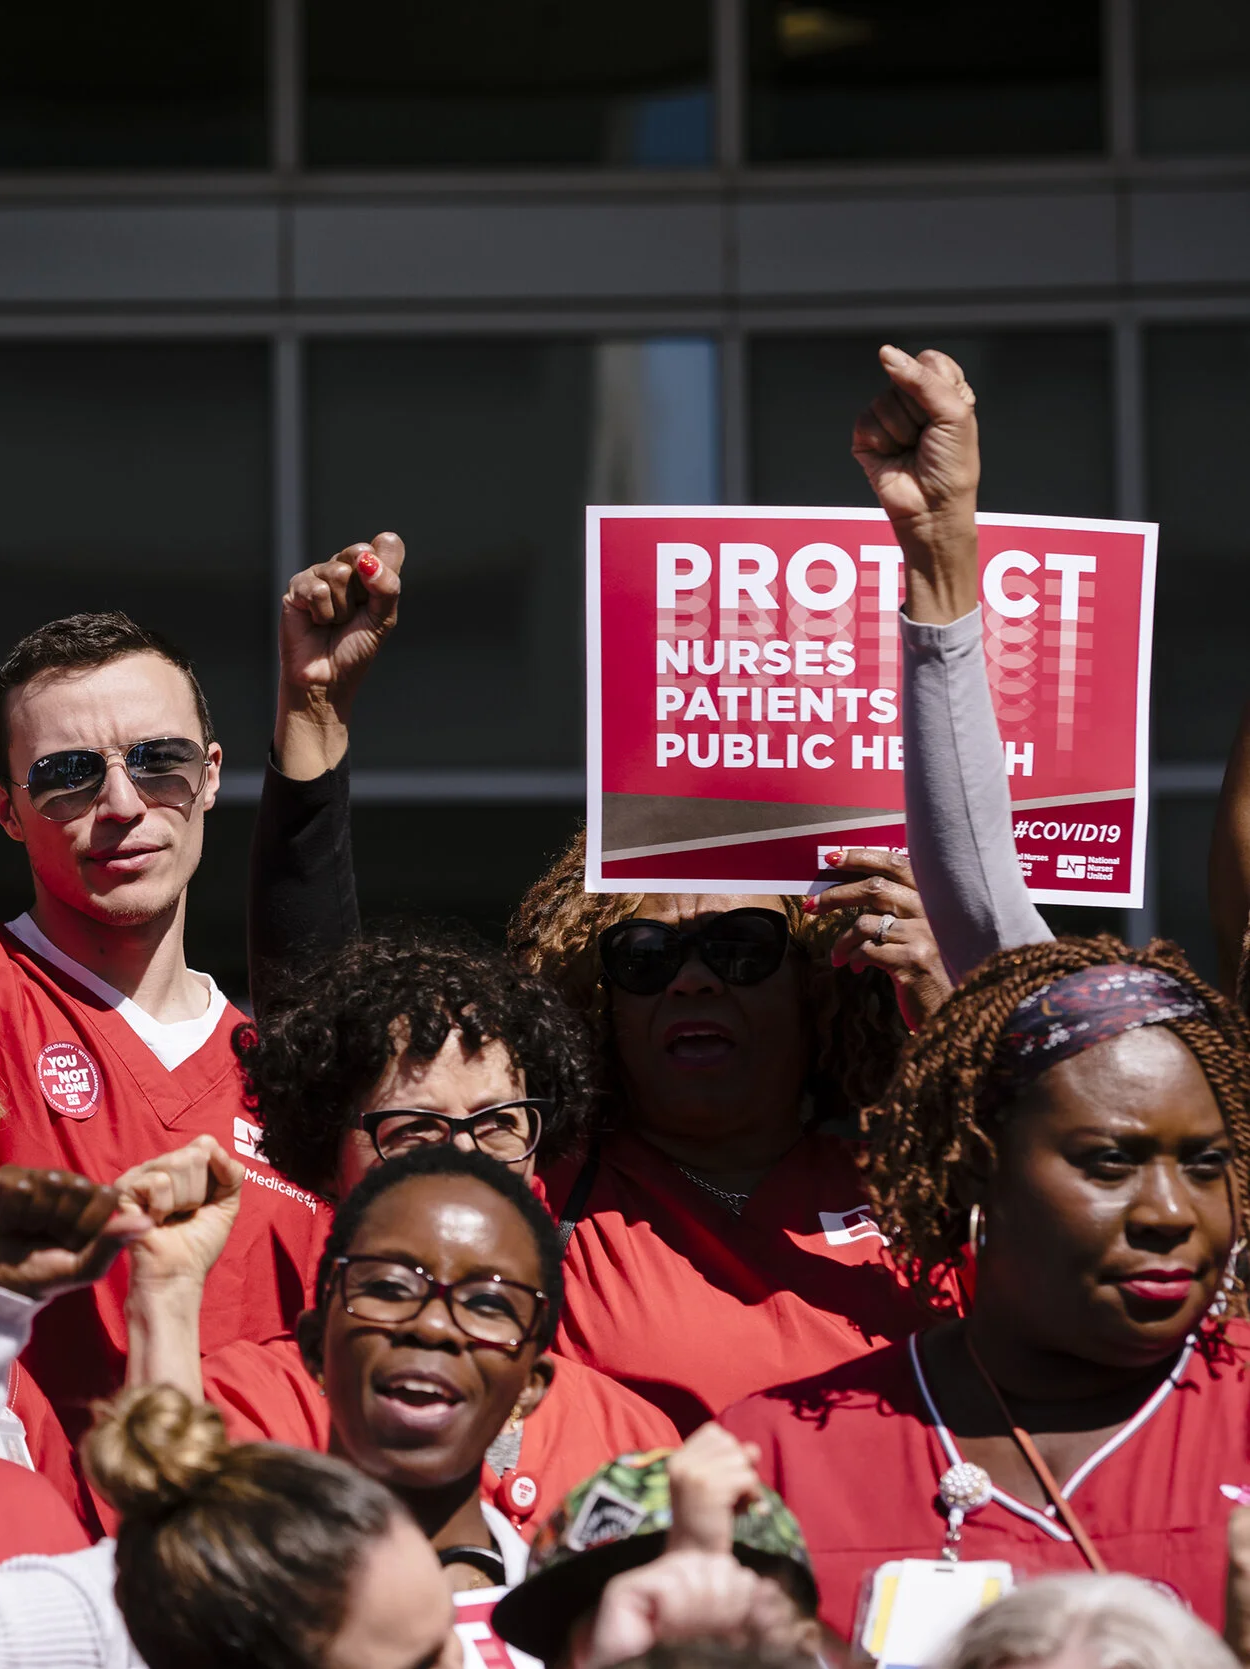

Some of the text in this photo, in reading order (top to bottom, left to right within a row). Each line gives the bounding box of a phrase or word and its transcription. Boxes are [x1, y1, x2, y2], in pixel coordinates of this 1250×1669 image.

[656, 542, 1097, 621] PROTCT
[656, 640, 856, 676] NURSES
[656, 686, 898, 724] PATIENTS
[656, 732, 1034, 777] PUBLIC HEH
[1013, 820, 1121, 843] #COVID19
[1087, 864, 1114, 873] Nurses
[1088, 856, 1120, 865] National
[1086, 872, 1113, 880] United
[47, 1054, 78, 1069] YOU
[43, 1068, 89, 1084] ARE NOT
[52, 1081, 91, 1094] ALONE
